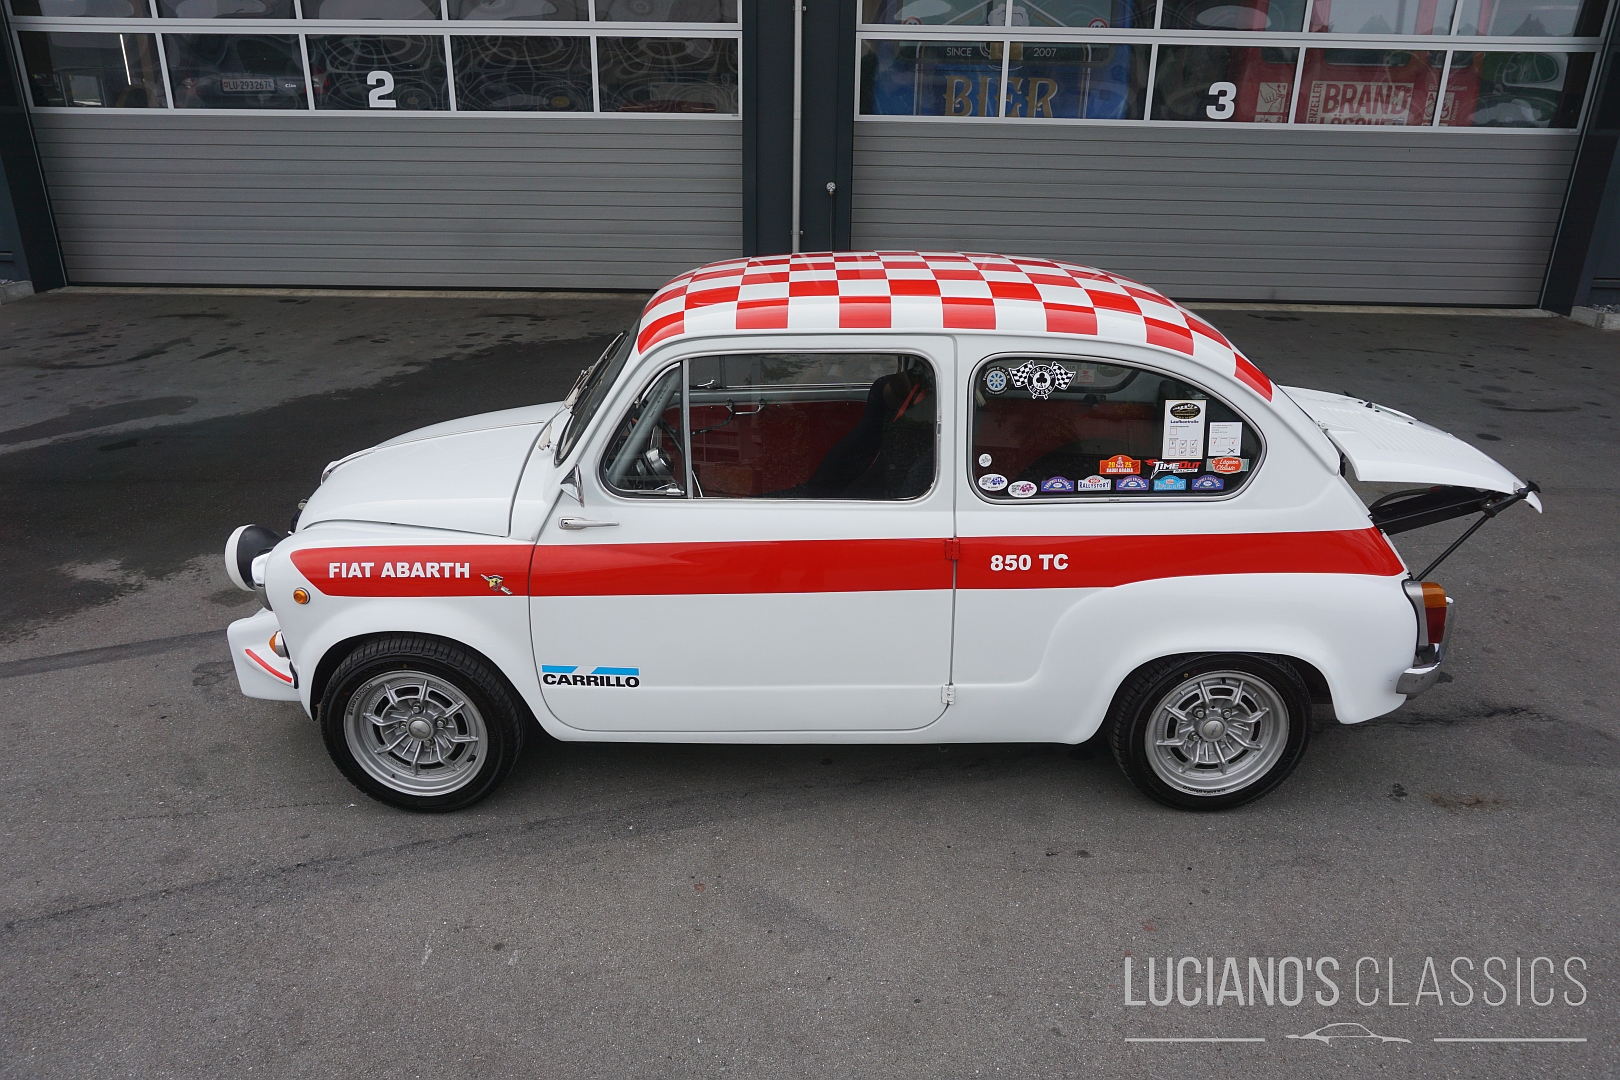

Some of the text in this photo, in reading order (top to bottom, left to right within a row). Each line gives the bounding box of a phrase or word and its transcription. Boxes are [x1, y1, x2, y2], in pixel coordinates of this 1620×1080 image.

[946, 47, 1057, 58] SINCE 2007
[366, 70, 397, 108] 2
[942, 75, 1058, 118] BIER
[1206, 82, 1236, 120] 3
[1322, 84, 1412, 115] BRAND
[1079, 480, 1110, 489] RALLYSTORY
[328, 561, 471, 579] FIAT ABARTH
[990, 553, 1069, 571] 850 TC
[543, 673, 640, 688] CARRILLO
